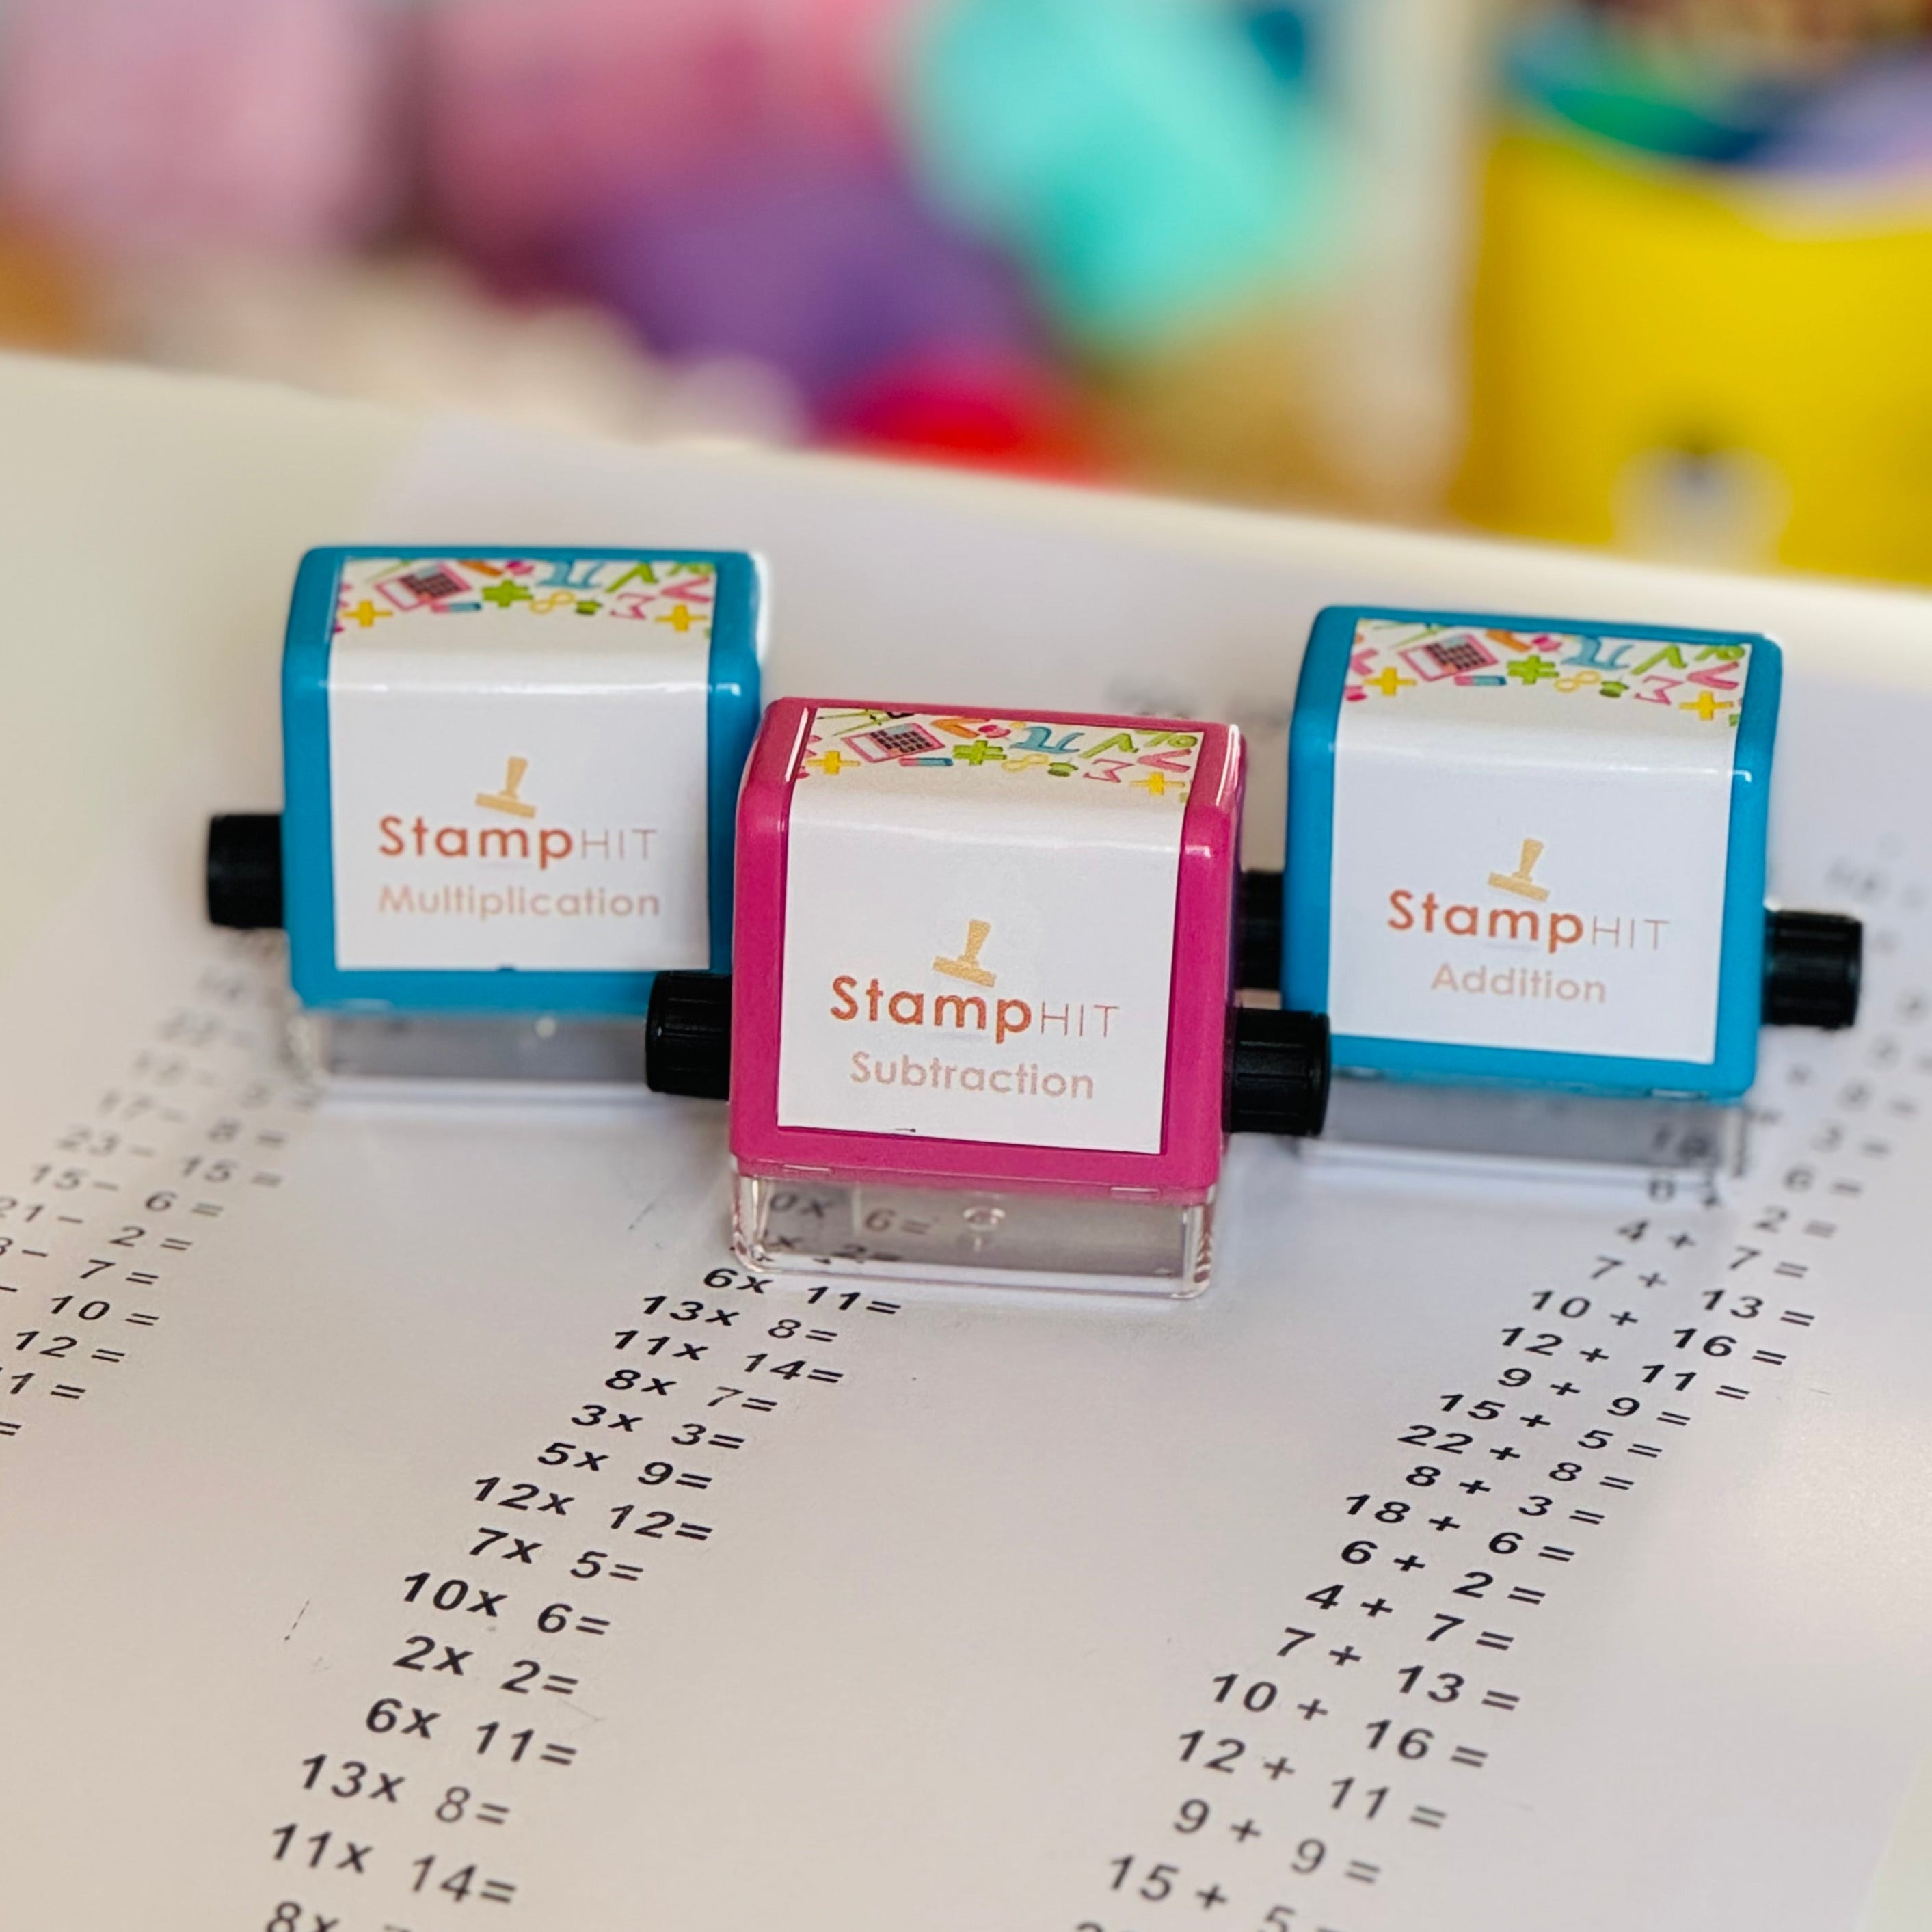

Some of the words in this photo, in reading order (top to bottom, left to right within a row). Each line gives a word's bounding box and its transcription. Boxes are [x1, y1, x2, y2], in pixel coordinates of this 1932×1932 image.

[377, 884, 660, 921] Multiplication
[1431, 961, 1607, 1004] Addition
[850, 1051, 1095, 1099] Subtraction
[181, 1155, 239, 1183] 15
[144, 1190, 178, 1212] 6
[1754, 1205, 1789, 1233] 2
[108, 1226, 146, 1248] 2
[159, 1237, 193, 1252] =
[1618, 1220, 1649, 1242] 4
[1669, 1233, 1696, 1249] +
[1729, 1248, 1761, 1270] 7
[1774, 1261, 1808, 1279] =
[79, 1258, 117, 1280] 7
[124, 1271, 160, 1286] =
[702, 1267, 774, 1296] 6x
[1590, 1256, 1624, 1280] 7
[1638, 1272, 1665, 1289] +
[1702, 1288, 1765, 1320] 13
[1778, 1309, 1816, 1328] =
[50, 1294, 111, 1321] 10
[124, 1312, 161, 1327] =
[642, 1294, 741, 1328] 13x
[1531, 1289, 1592, 1319] 10
[1609, 1310, 1639, 1328] +
[1672, 1327, 1739, 1358] 16
[1750, 1348, 1788, 1367] =
[14, 1330, 79, 1359] 12
[90, 1347, 126, 1364] =
[613, 1329, 710, 1363] 11x
[1501, 1326, 1564, 1358] 12
[1578, 1347, 1610, 1364] +
[1641, 1363, 1698, 1393] 11
[1714, 1384, 1752, 1401] =
[49, 1383, 88, 1401] =
[604, 1368, 678, 1397] 8x
[1496, 1367, 1533, 1388] 9
[1548, 1381, 1582, 1397] +
[1605, 1396, 1641, 1418] 9
[1655, 1410, 1692, 1427] =
[569, 1404, 645, 1434] 3x
[1439, 1393, 1507, 1421] 15
[1518, 1413, 1552, 1429] +
[1576, 1428, 1615, 1450] 5
[1626, 1443, 1664, 1460] =
[536, 1441, 611, 1473] 5x
[1396, 1423, 1475, 1455] 22
[1488, 1445, 1522, 1462] +
[1547, 1461, 1584, 1483] 8
[1598, 1475, 1635, 1492] =
[473, 1475, 576, 1517] 12x
[1404, 1464, 1443, 1488] 8
[1458, 1479, 1492, 1496] +
[1517, 1494, 1554, 1518] 3
[1568, 1508, 1606, 1526] =
[468, 1526, 544, 1565] 7x
[1345, 1493, 1412, 1525] 18
[1427, 1515, 1462, 1533] +
[1487, 1531, 1525, 1555] 6
[1536, 1544, 1577, 1564] =
[403, 1571, 509, 1619] 10x
[1340, 1539, 1379, 1566] 6
[1392, 1554, 1427, 1573] +
[1451, 1570, 1494, 1600] 2
[1506, 1585, 1547, 1606] =
[1304, 1583, 1345, 1611] 4
[1359, 1597, 1394, 1619] +
[1425, 1612, 1466, 1643] 7
[1475, 1630, 1515, 1652] =
[391, 1634, 475, 1677] 2x
[1276, 1626, 1317, 1658] 7
[1328, 1644, 1363, 1667] +
[1397, 1664, 1466, 1704] 13
[1480, 1689, 1521, 1712] =
[364, 1697, 442, 1741] 6x
[1212, 1672, 1278, 1714] 10
[1296, 1698, 1329, 1722] +
[1365, 1718, 1436, 1761] 16
[1449, 1745, 1489, 1769] =
[301, 1753, 406, 1804] 13x
[1178, 1728, 1247, 1775] 12
[1262, 1756, 1296, 1782] +
[1330, 1776, 1391, 1821] 11
[1409, 1805, 1447, 1829] =
[272, 1822, 373, 1875] 11x
[1172, 1797, 1211, 1835] 9
[1229, 1818, 1261, 1844] +
[1291, 1838, 1327, 1875] 9
[1345, 1860, 1380, 1885] =
[1110, 1854, 1180, 1903] 15
[1195, 1883, 1228, 1911] +
